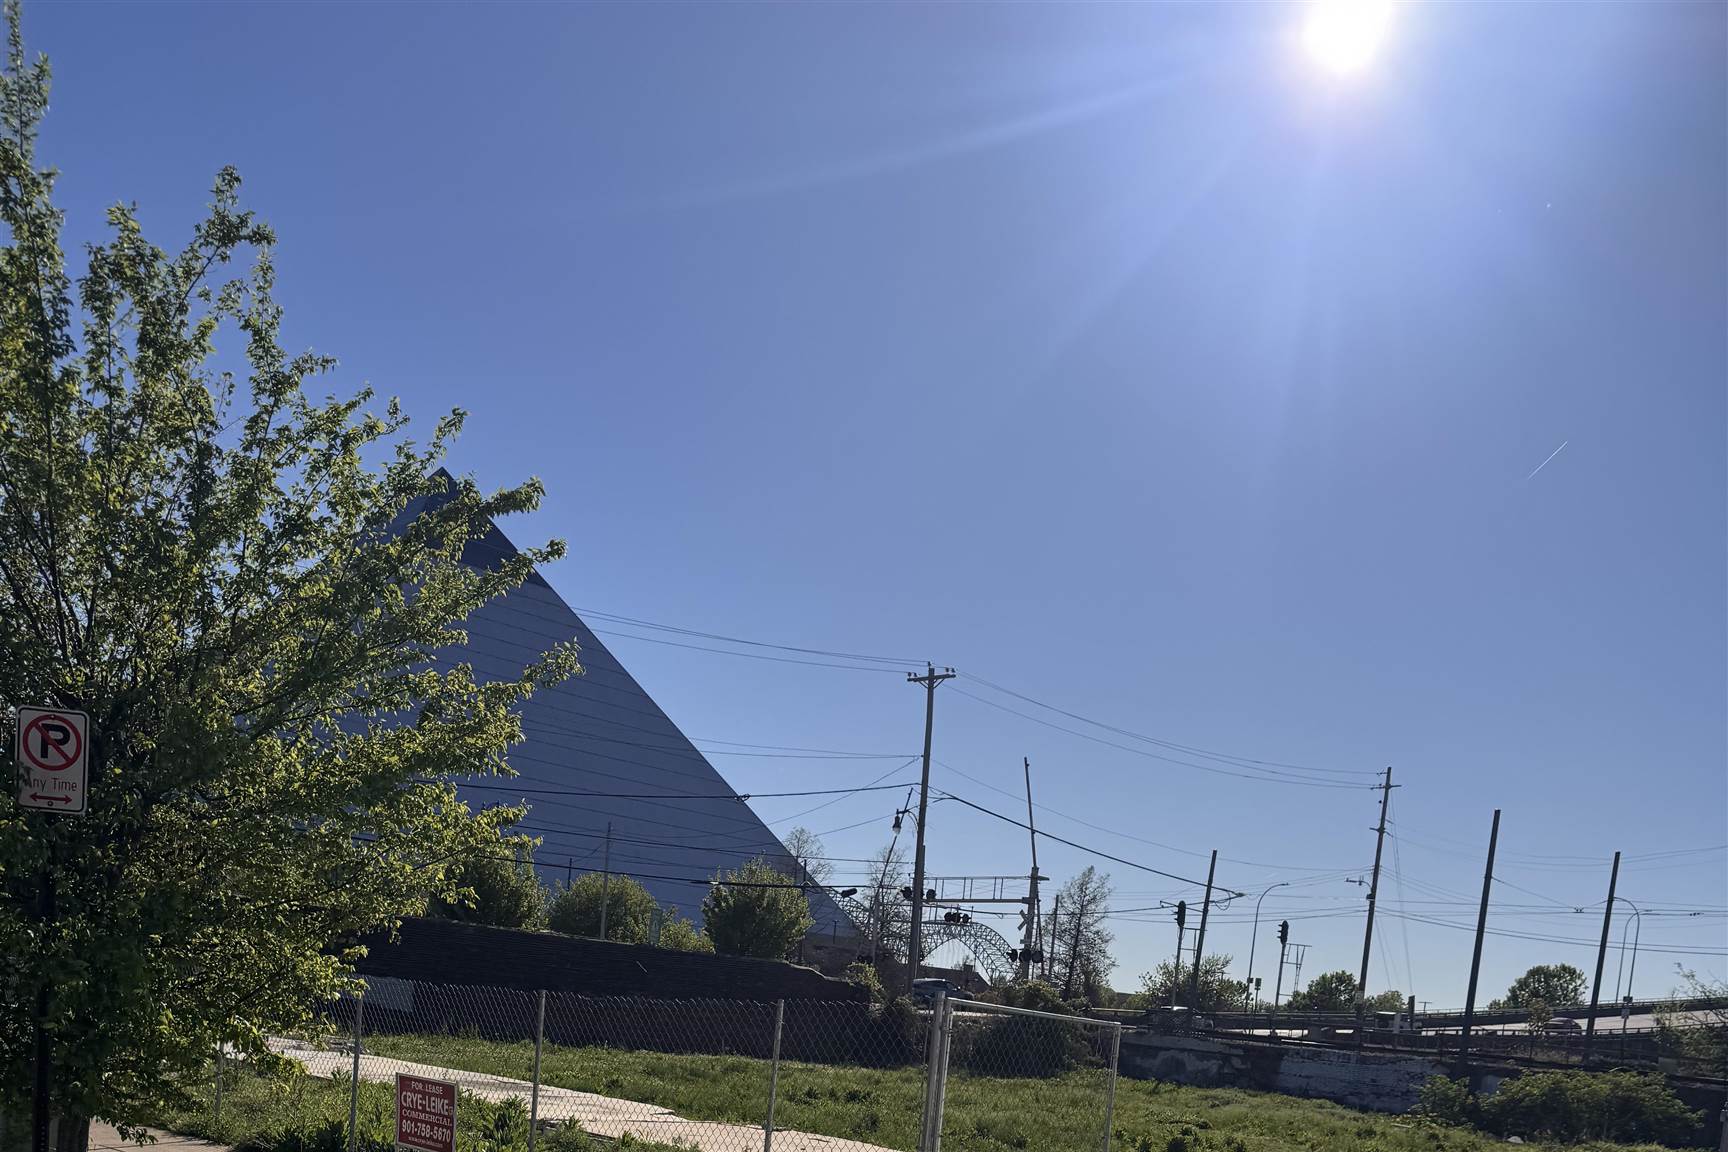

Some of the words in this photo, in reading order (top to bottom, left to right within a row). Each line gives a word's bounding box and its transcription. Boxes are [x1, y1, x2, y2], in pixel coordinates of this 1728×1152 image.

[51, 777, 77, 792] Time
[411, 1081, 423, 1091] FOR
[425, 1083, 443, 1095] LEASE
[401, 1091, 449, 1116] CRYE-LEIKE
[402, 1108, 452, 1127] COMMERCIAL
[402, 1119, 451, 1143] 901-758-5670
